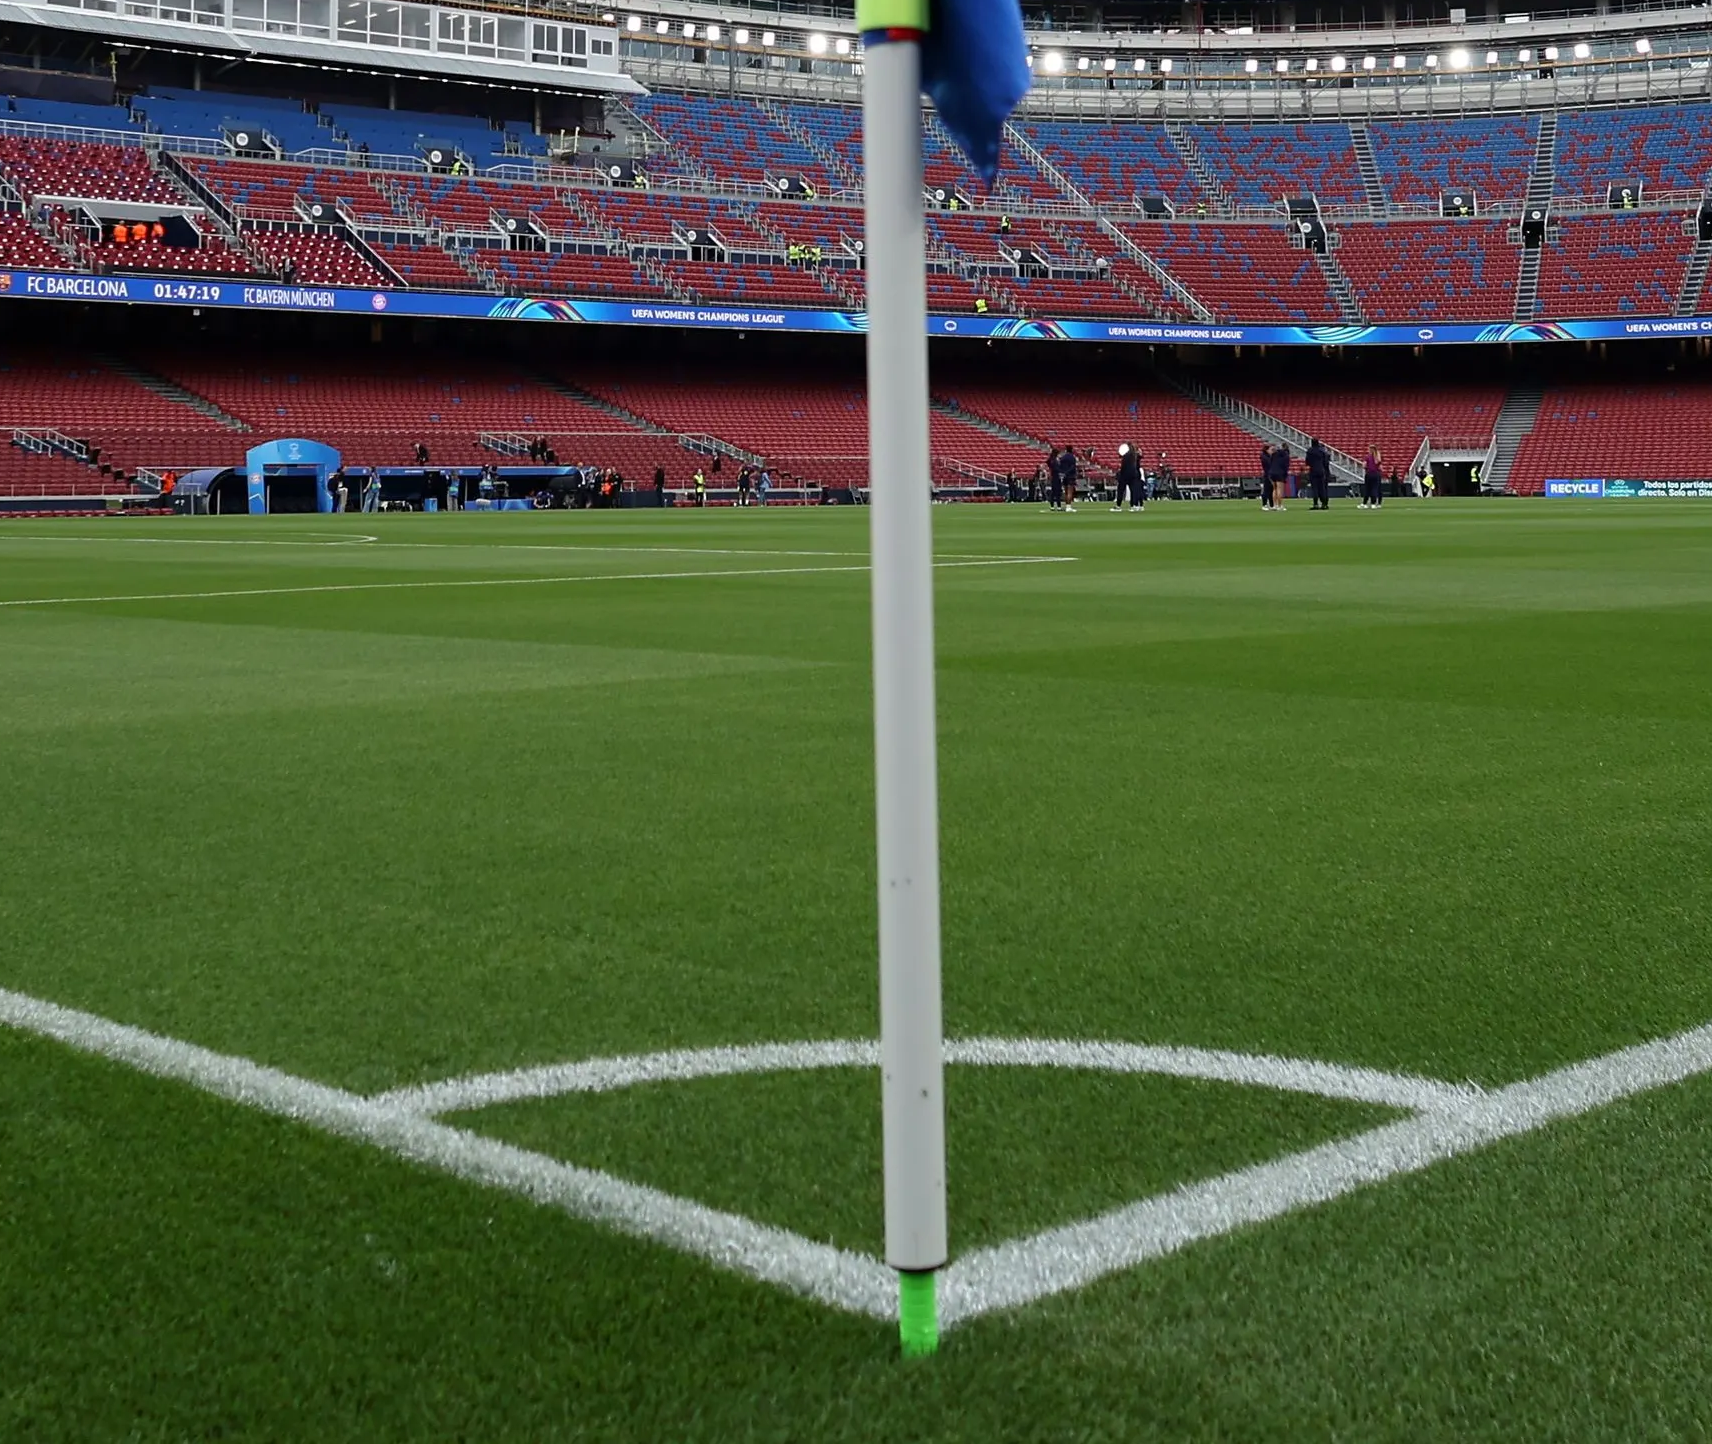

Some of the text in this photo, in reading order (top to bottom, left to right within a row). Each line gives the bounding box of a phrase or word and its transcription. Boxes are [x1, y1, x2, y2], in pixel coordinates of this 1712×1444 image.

[27, 276, 129, 298] FC BARCELONA
[154, 282, 220, 301] 01:47:19
[244, 287, 336, 308] FC BAYERN MÜNCHEN
[631, 308, 654, 319] UEFA
[697, 311, 750, 323] CHAMPIONS
[1108, 327, 1127, 336] UEFA
[1163, 328, 1210, 339] CHAMPIONS
[1625, 323, 1650, 333] UEFA
[1550, 483, 1599, 494] RECYCLE
[1643, 480, 1667, 489] Todos
[1667, 480, 1679, 488] los
[1680, 480, 1712, 490] partidos
[1638, 488, 1668, 497] directo.
[1668, 488, 1686, 497] Solo
[1687, 489, 1698, 497] en
